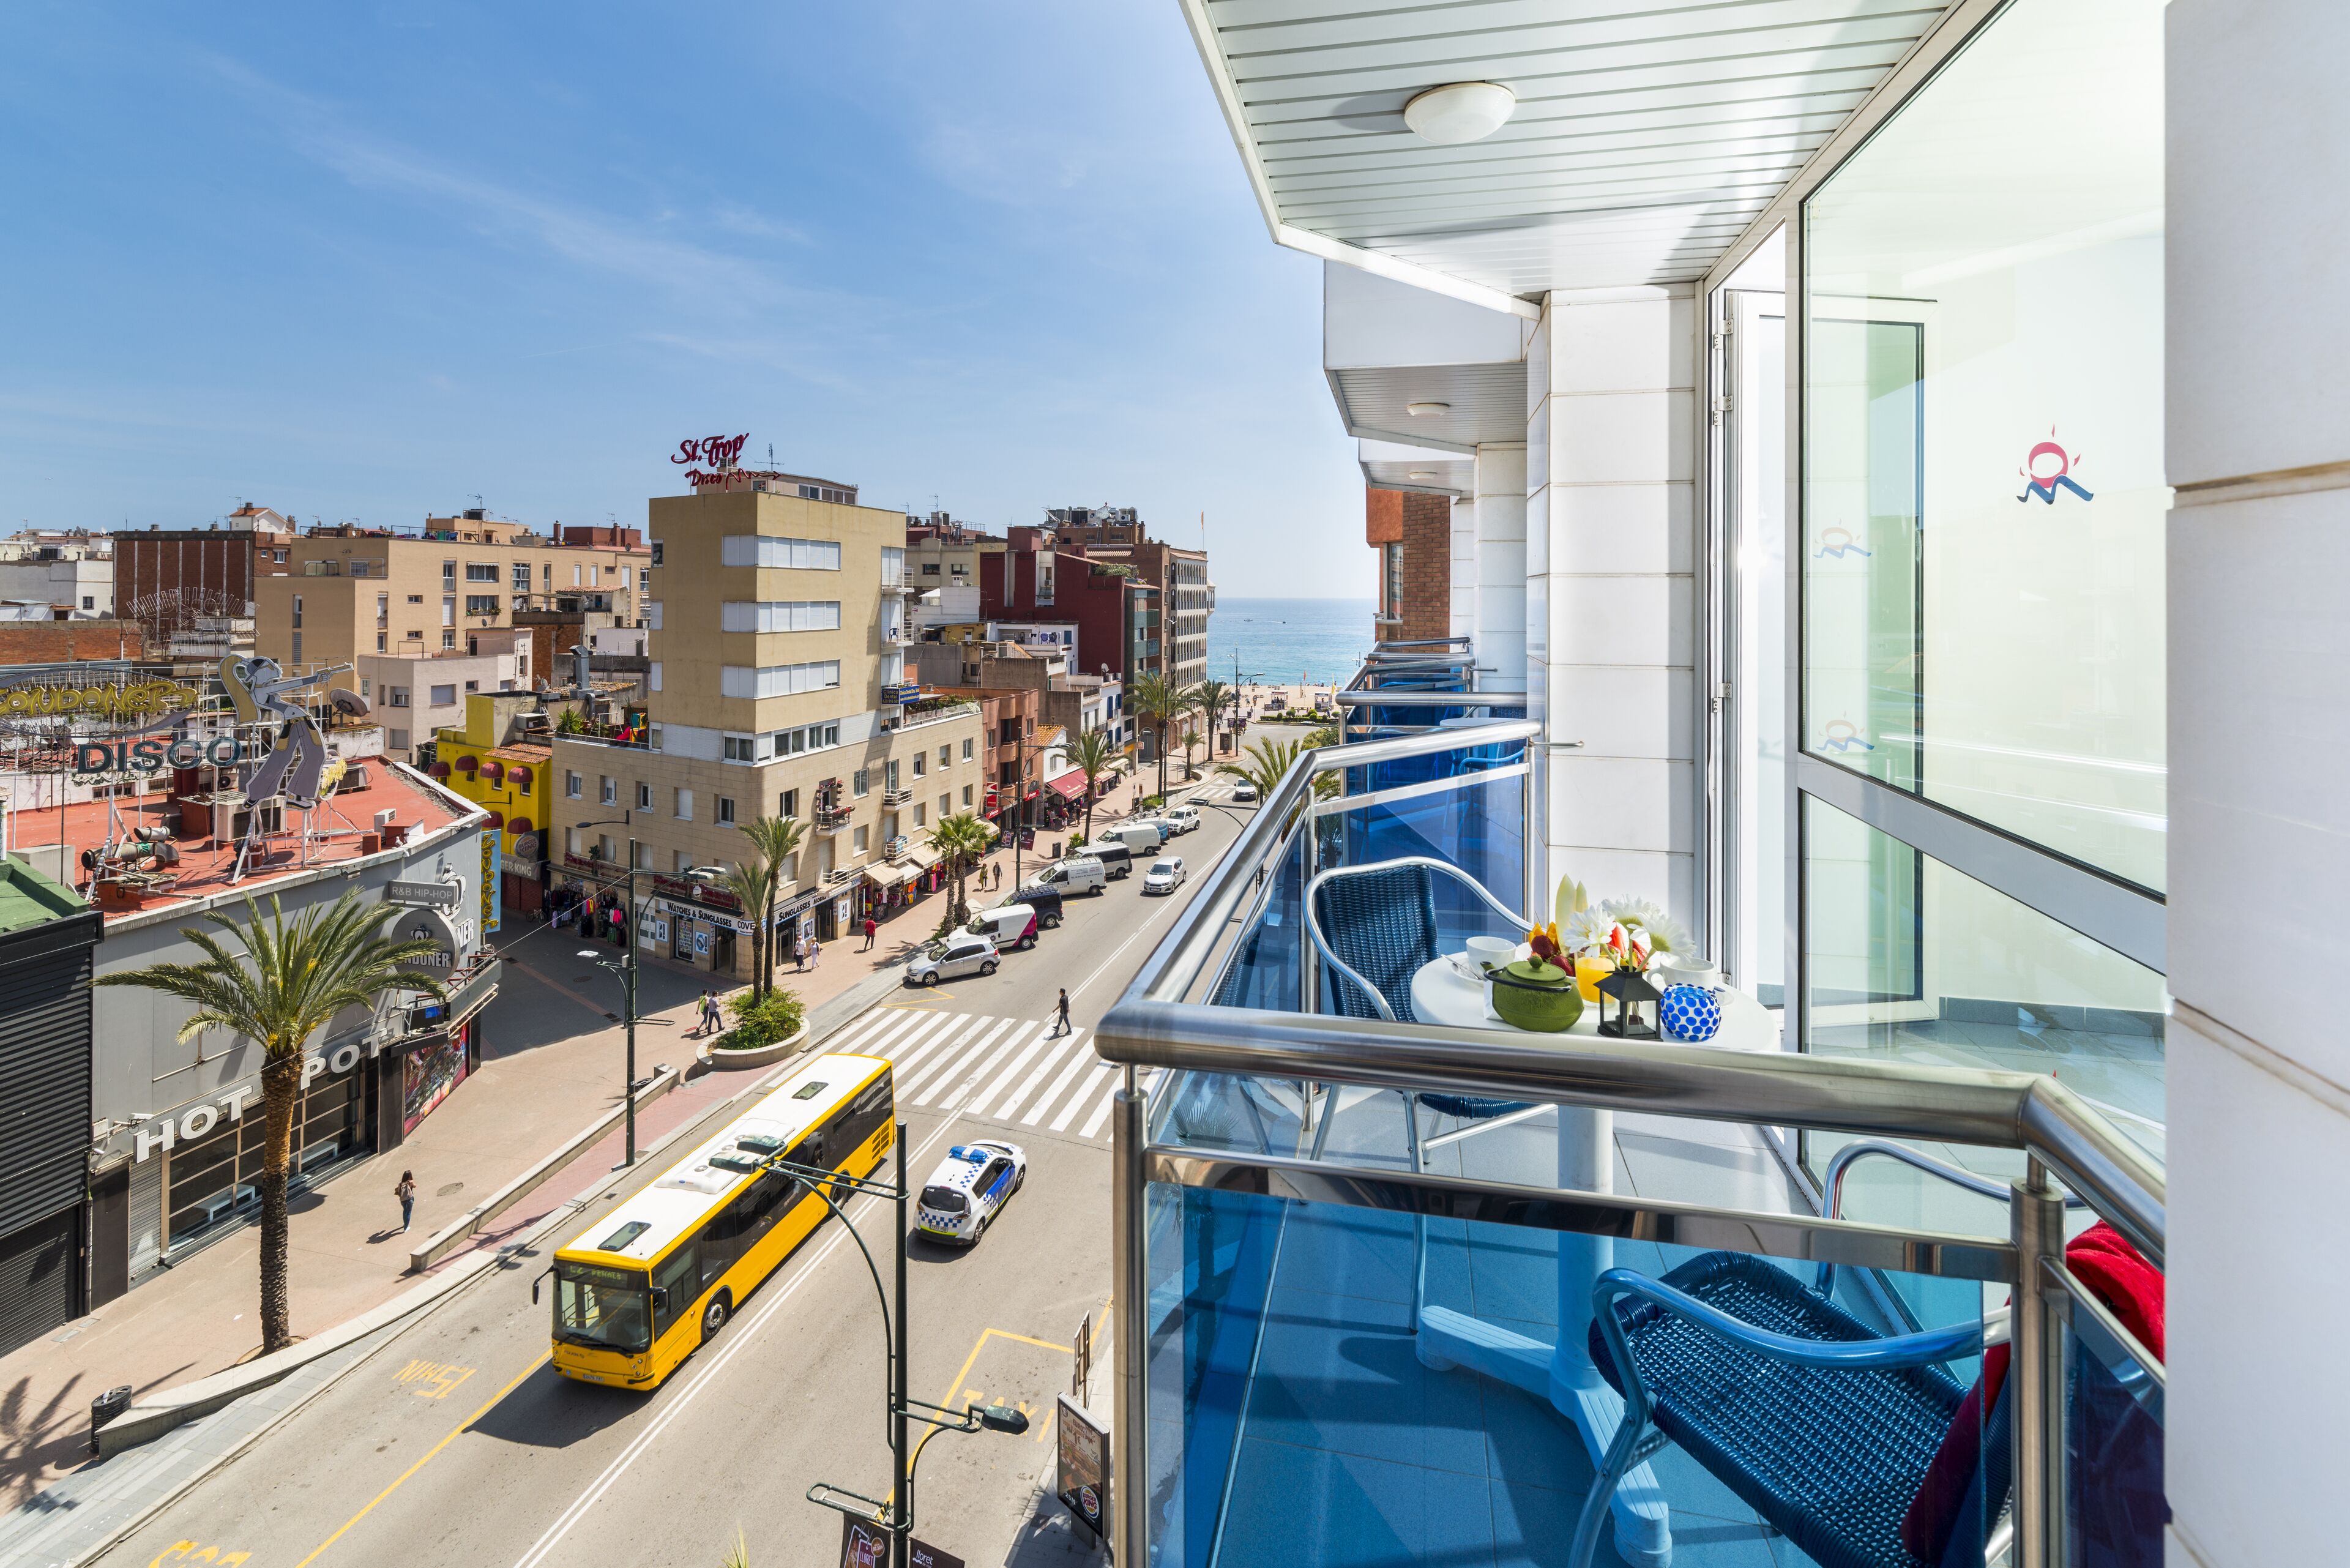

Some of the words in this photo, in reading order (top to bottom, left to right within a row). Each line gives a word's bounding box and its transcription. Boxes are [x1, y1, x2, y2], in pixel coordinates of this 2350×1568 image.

[0, 681, 198, 716] ONDONER
[77, 737, 242, 774] DISCO
[521, 842, 537, 853] KING
[501, 859, 513, 871] GER
[514, 862, 532, 876] KING
[392, 886, 412, 897] R&B
[414, 889, 453, 902] HIP-HOP
[737, 920, 756, 930] COVE
[300, 1028, 388, 1091] POT
[133, 1085, 253, 1163] HOT
[1083, 1492, 1097, 1502] BURGER
[1083, 1498, 1097, 1510] KING
[859, 1551, 874, 1566] LLORET
[916, 1549, 934, 1565] lloret
